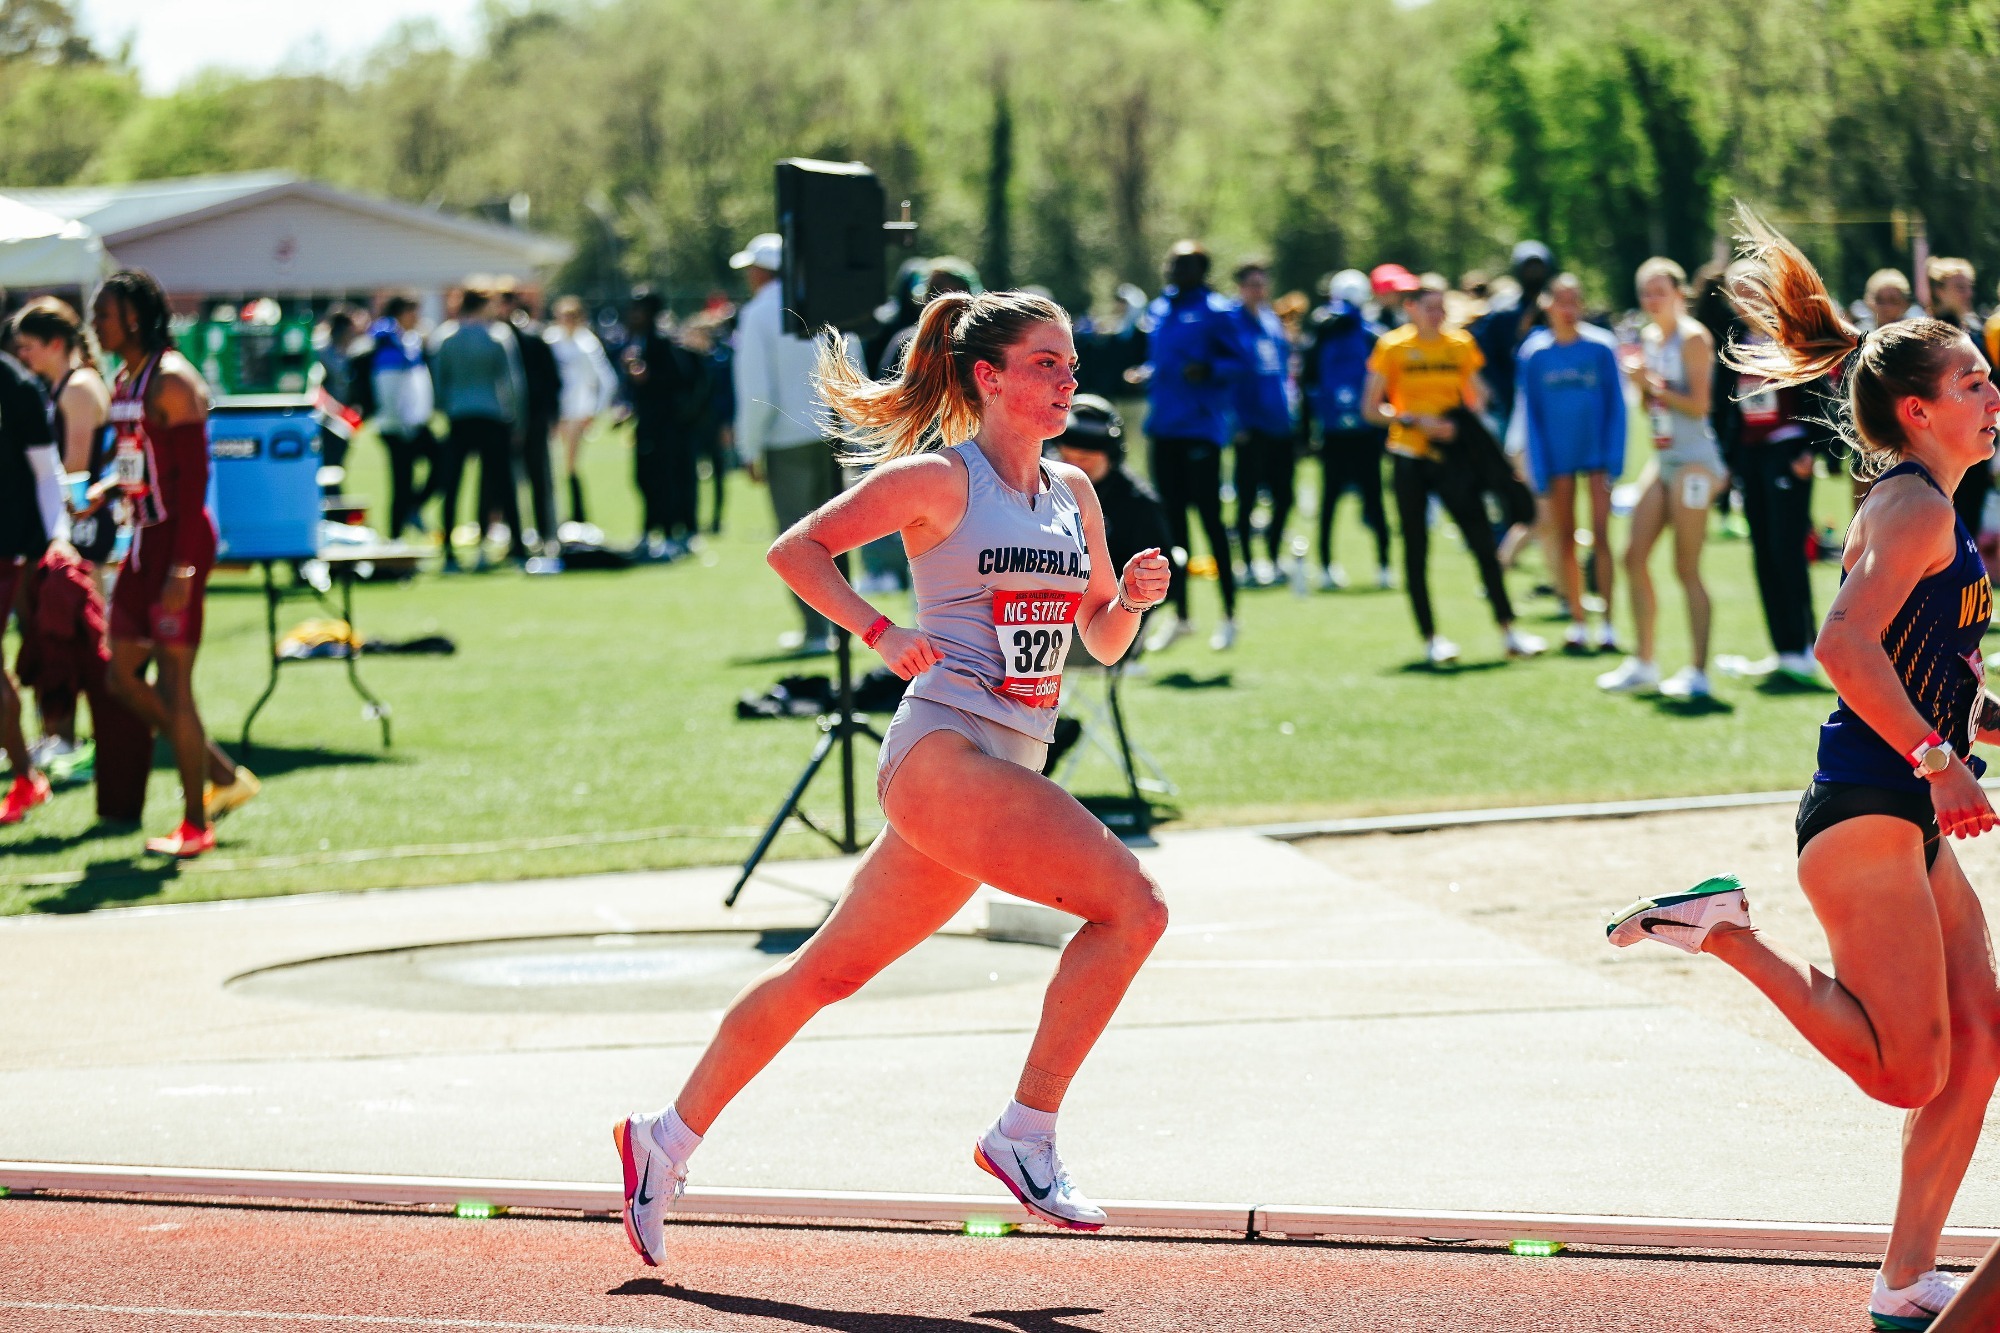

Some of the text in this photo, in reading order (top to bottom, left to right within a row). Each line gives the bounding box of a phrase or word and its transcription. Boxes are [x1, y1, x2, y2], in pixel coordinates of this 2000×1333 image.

[1003, 601, 1072, 623] NC STATE
[1013, 629, 1064, 674] 328
